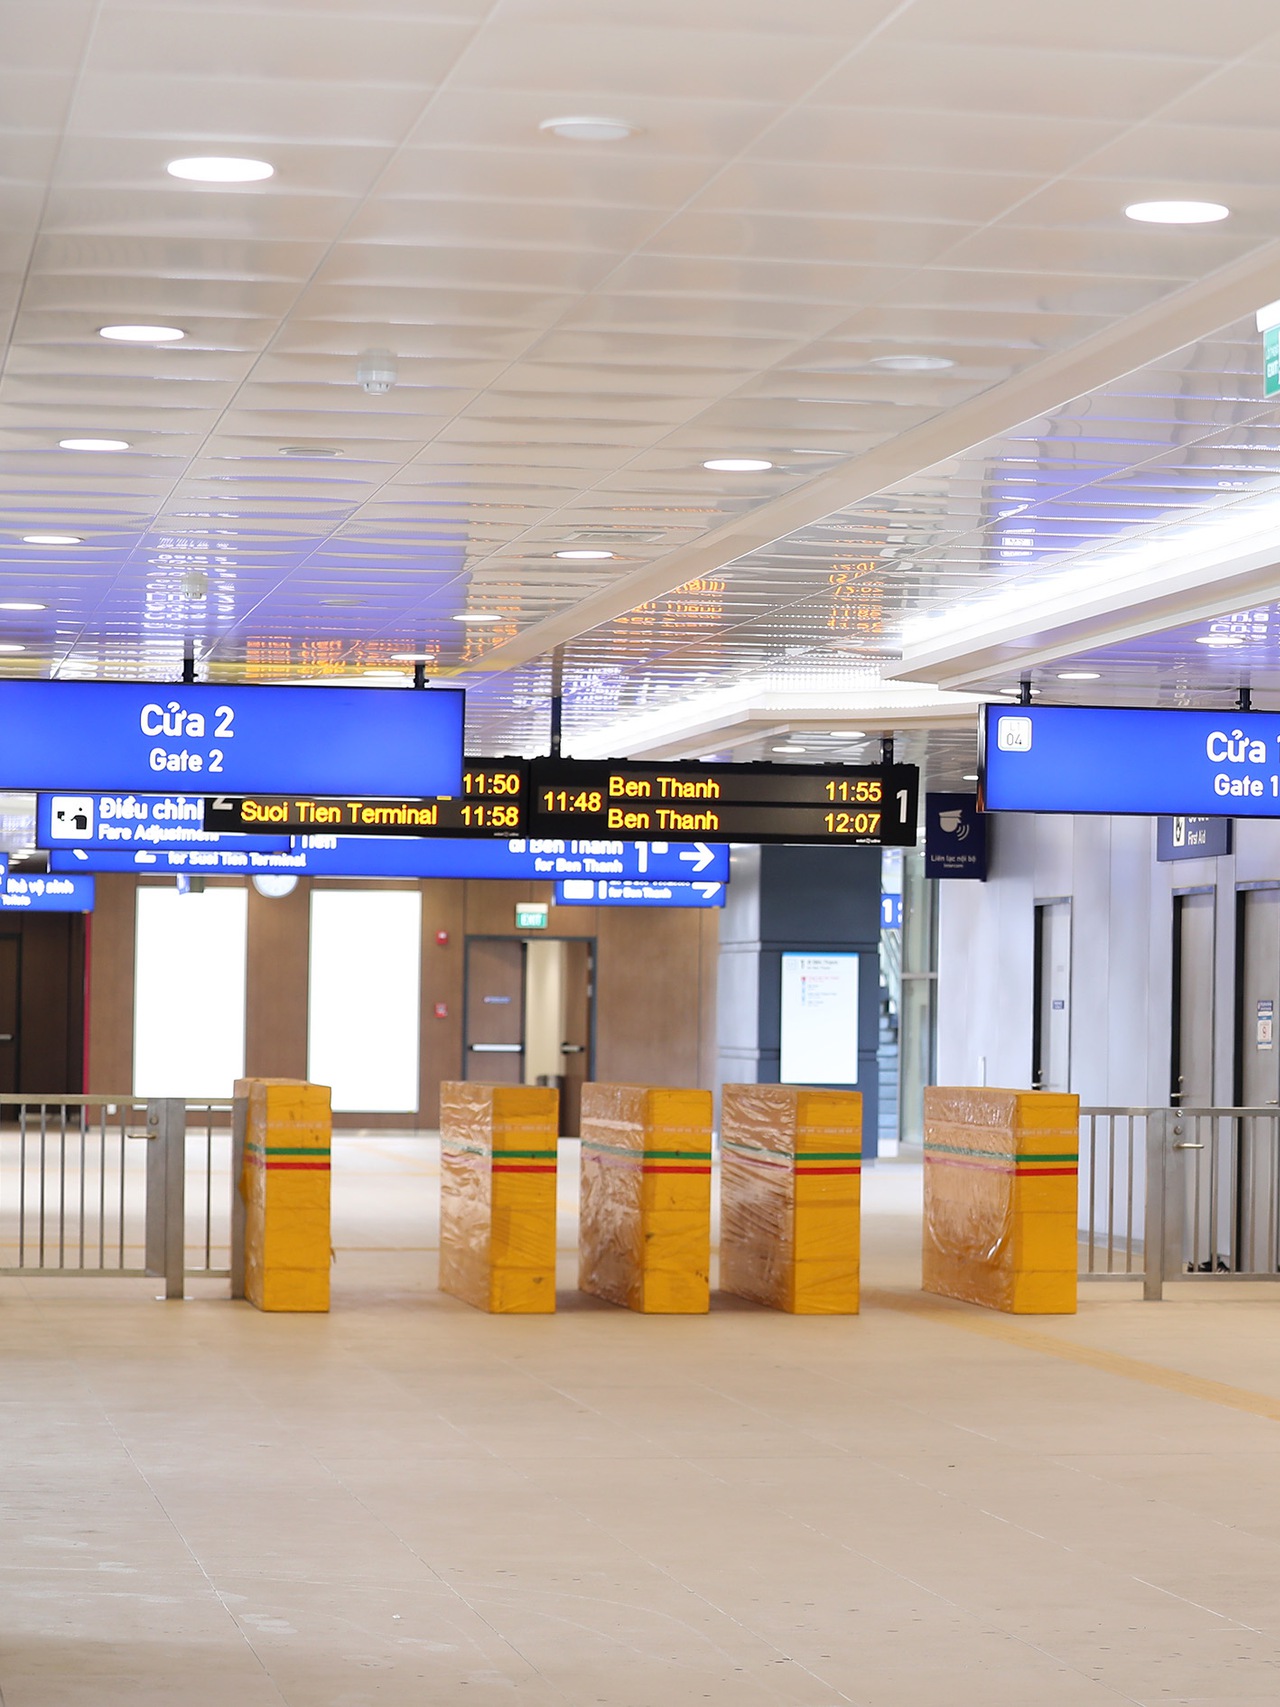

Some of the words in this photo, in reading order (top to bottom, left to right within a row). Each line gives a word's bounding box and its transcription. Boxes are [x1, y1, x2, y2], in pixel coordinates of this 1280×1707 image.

[140, 701, 206, 737] Cửa
[214, 705, 235, 738] 2
[1006, 733, 1022, 746] 04
[1206, 729, 1267, 763] Cửa
[149, 747, 204, 772] Gate
[208, 748, 224, 773] 2
[462, 773, 520, 795] 11:50
[608, 776, 651, 797] Ben
[656, 778, 720, 799] Thanh
[825, 781, 882, 802] 11:55
[1214, 773, 1264, 797] Gate
[1270, 775, 1279, 797] 1
[240, 802, 289, 822] Suoi
[295, 801, 342, 823] Tien
[347, 802, 437, 826] Terminal
[460, 805, 519, 827] 11:58
[543, 791, 602, 812] 11:48
[896, 789, 908, 824] 1
[98, 824, 132, 841] Fare
[607, 808, 649, 829] Ben
[655, 809, 719, 831] Thanh
[824, 812, 881, 833] 12:07
[534, 857, 555, 873] for
[555, 857, 582, 873] Ben
[582, 858, 624, 874] Thanh
